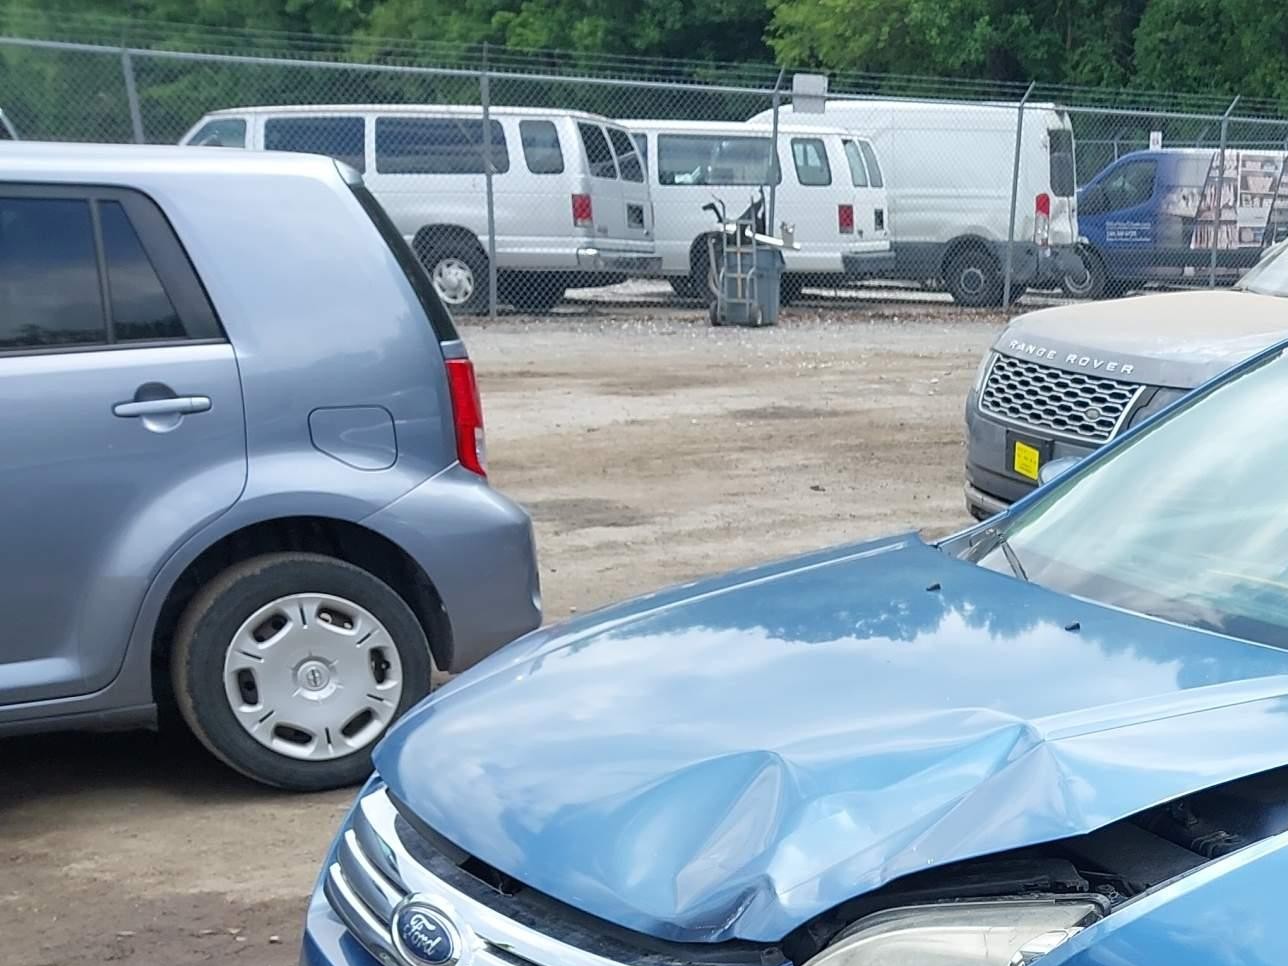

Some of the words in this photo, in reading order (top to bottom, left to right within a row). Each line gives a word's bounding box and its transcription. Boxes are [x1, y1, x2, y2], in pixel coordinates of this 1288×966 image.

[1008, 340, 1057, 360] RANGE
[1065, 353, 1134, 375] ROVER
[404, 913, 442, 956] Ford
